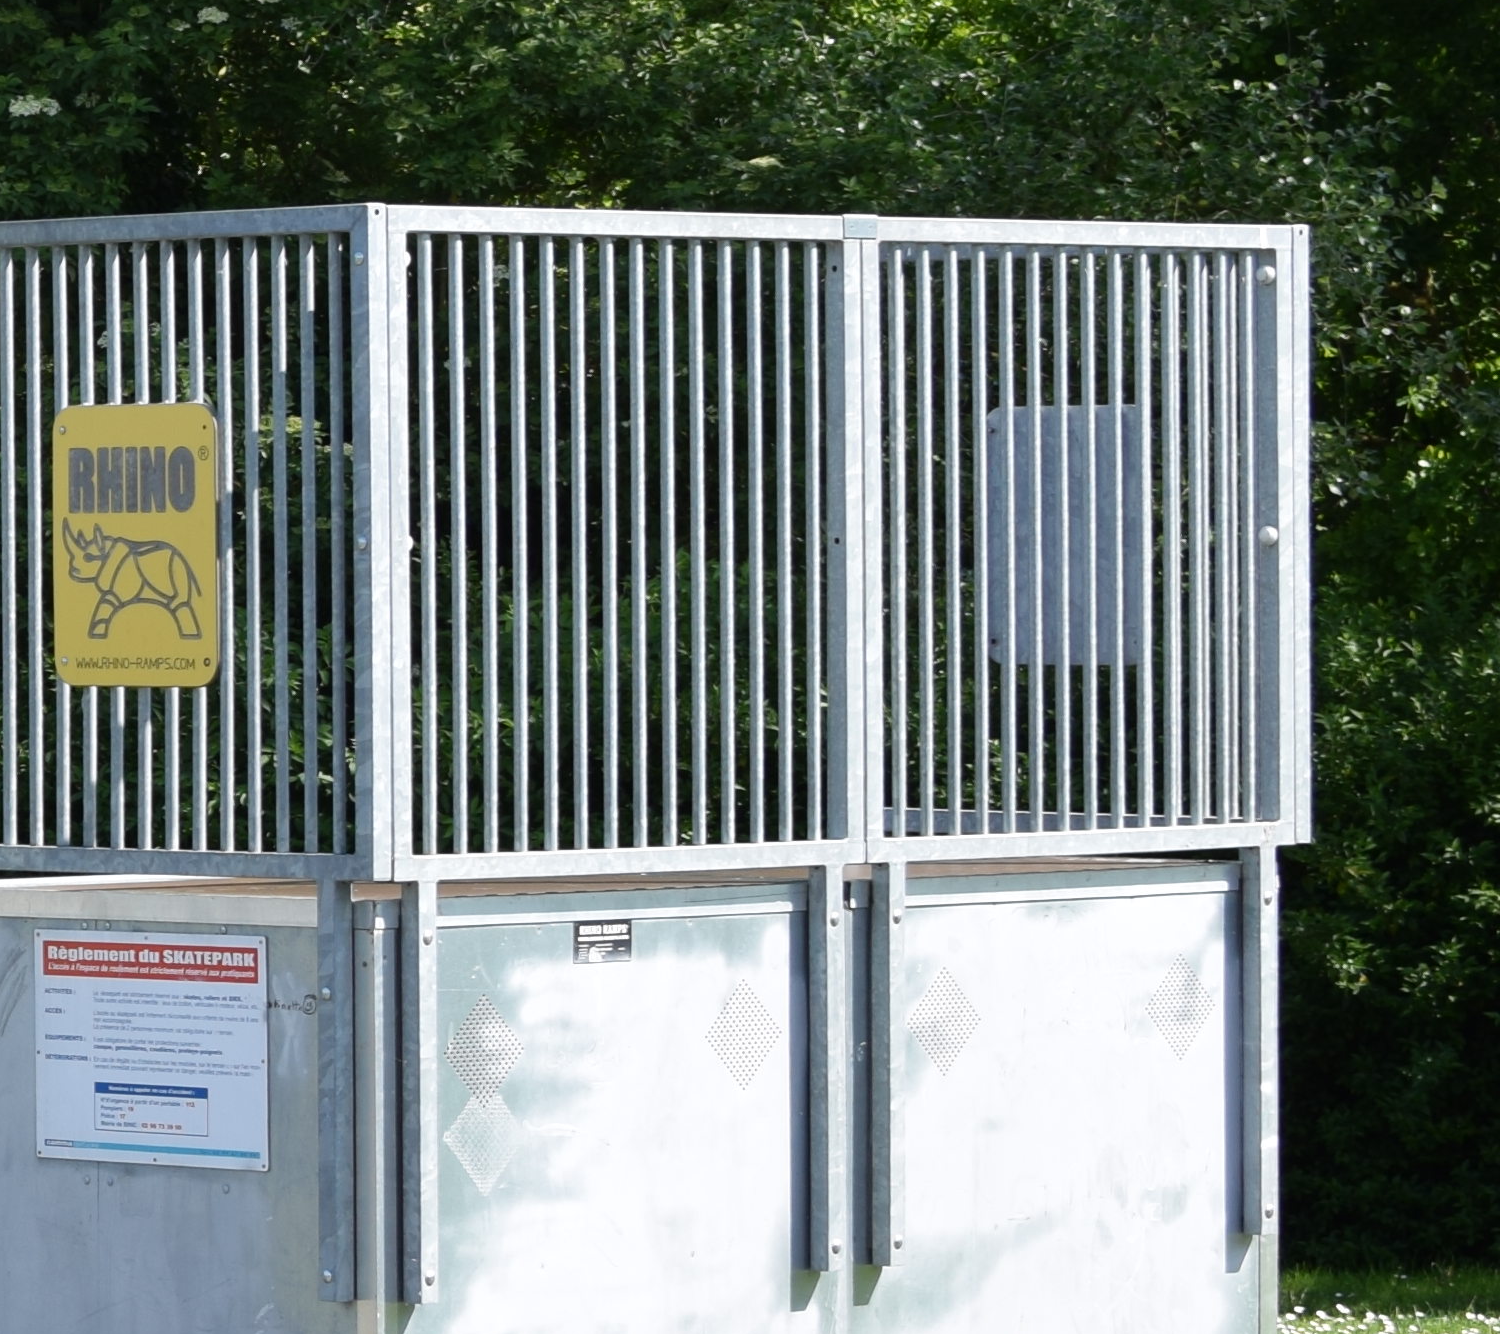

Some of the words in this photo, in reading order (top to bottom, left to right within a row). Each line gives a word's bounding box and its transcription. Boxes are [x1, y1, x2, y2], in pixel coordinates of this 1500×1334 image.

[68, 446, 196, 514] RHINO
[75, 656, 196, 671] WWW.RHINO-RAMPS.COM
[48, 945, 136, 964] Règlement
[138, 950, 159, 964] du
[163, 950, 255, 967] SKATEPARK
